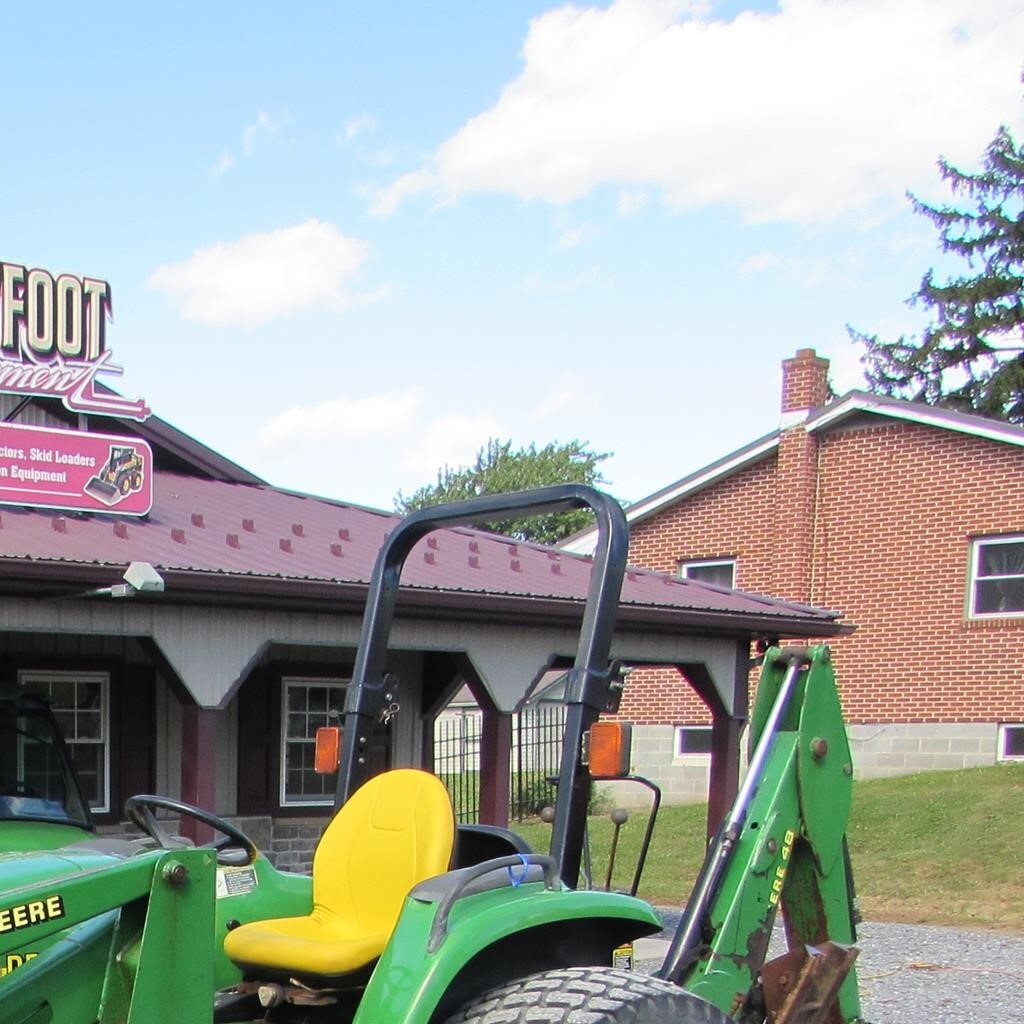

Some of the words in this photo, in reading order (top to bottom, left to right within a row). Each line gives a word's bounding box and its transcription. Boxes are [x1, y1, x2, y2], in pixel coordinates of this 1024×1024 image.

[29, 448, 52, 462] Skid
[55, 450, 96, 467] Loaders
[11, 466, 67, 483] Equipment
